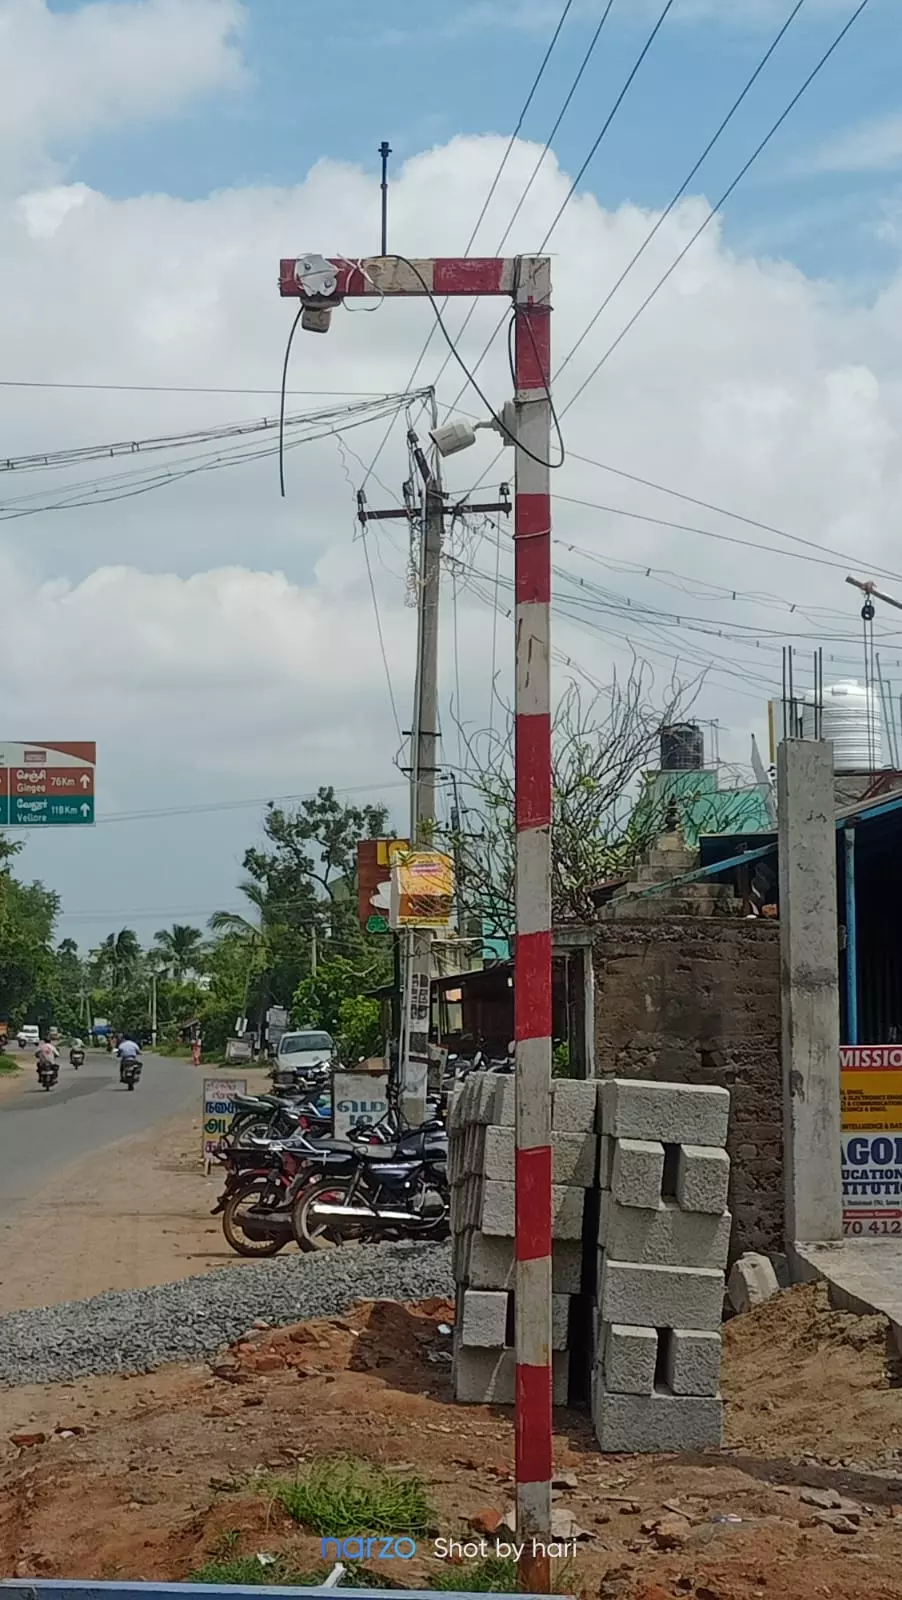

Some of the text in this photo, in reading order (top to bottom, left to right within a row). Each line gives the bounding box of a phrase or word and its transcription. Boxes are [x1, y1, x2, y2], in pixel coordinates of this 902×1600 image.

[16, 769, 47, 783] செஞ்சி
[16, 783, 46, 794] Gingee
[16, 813, 48, 823] Vellore
